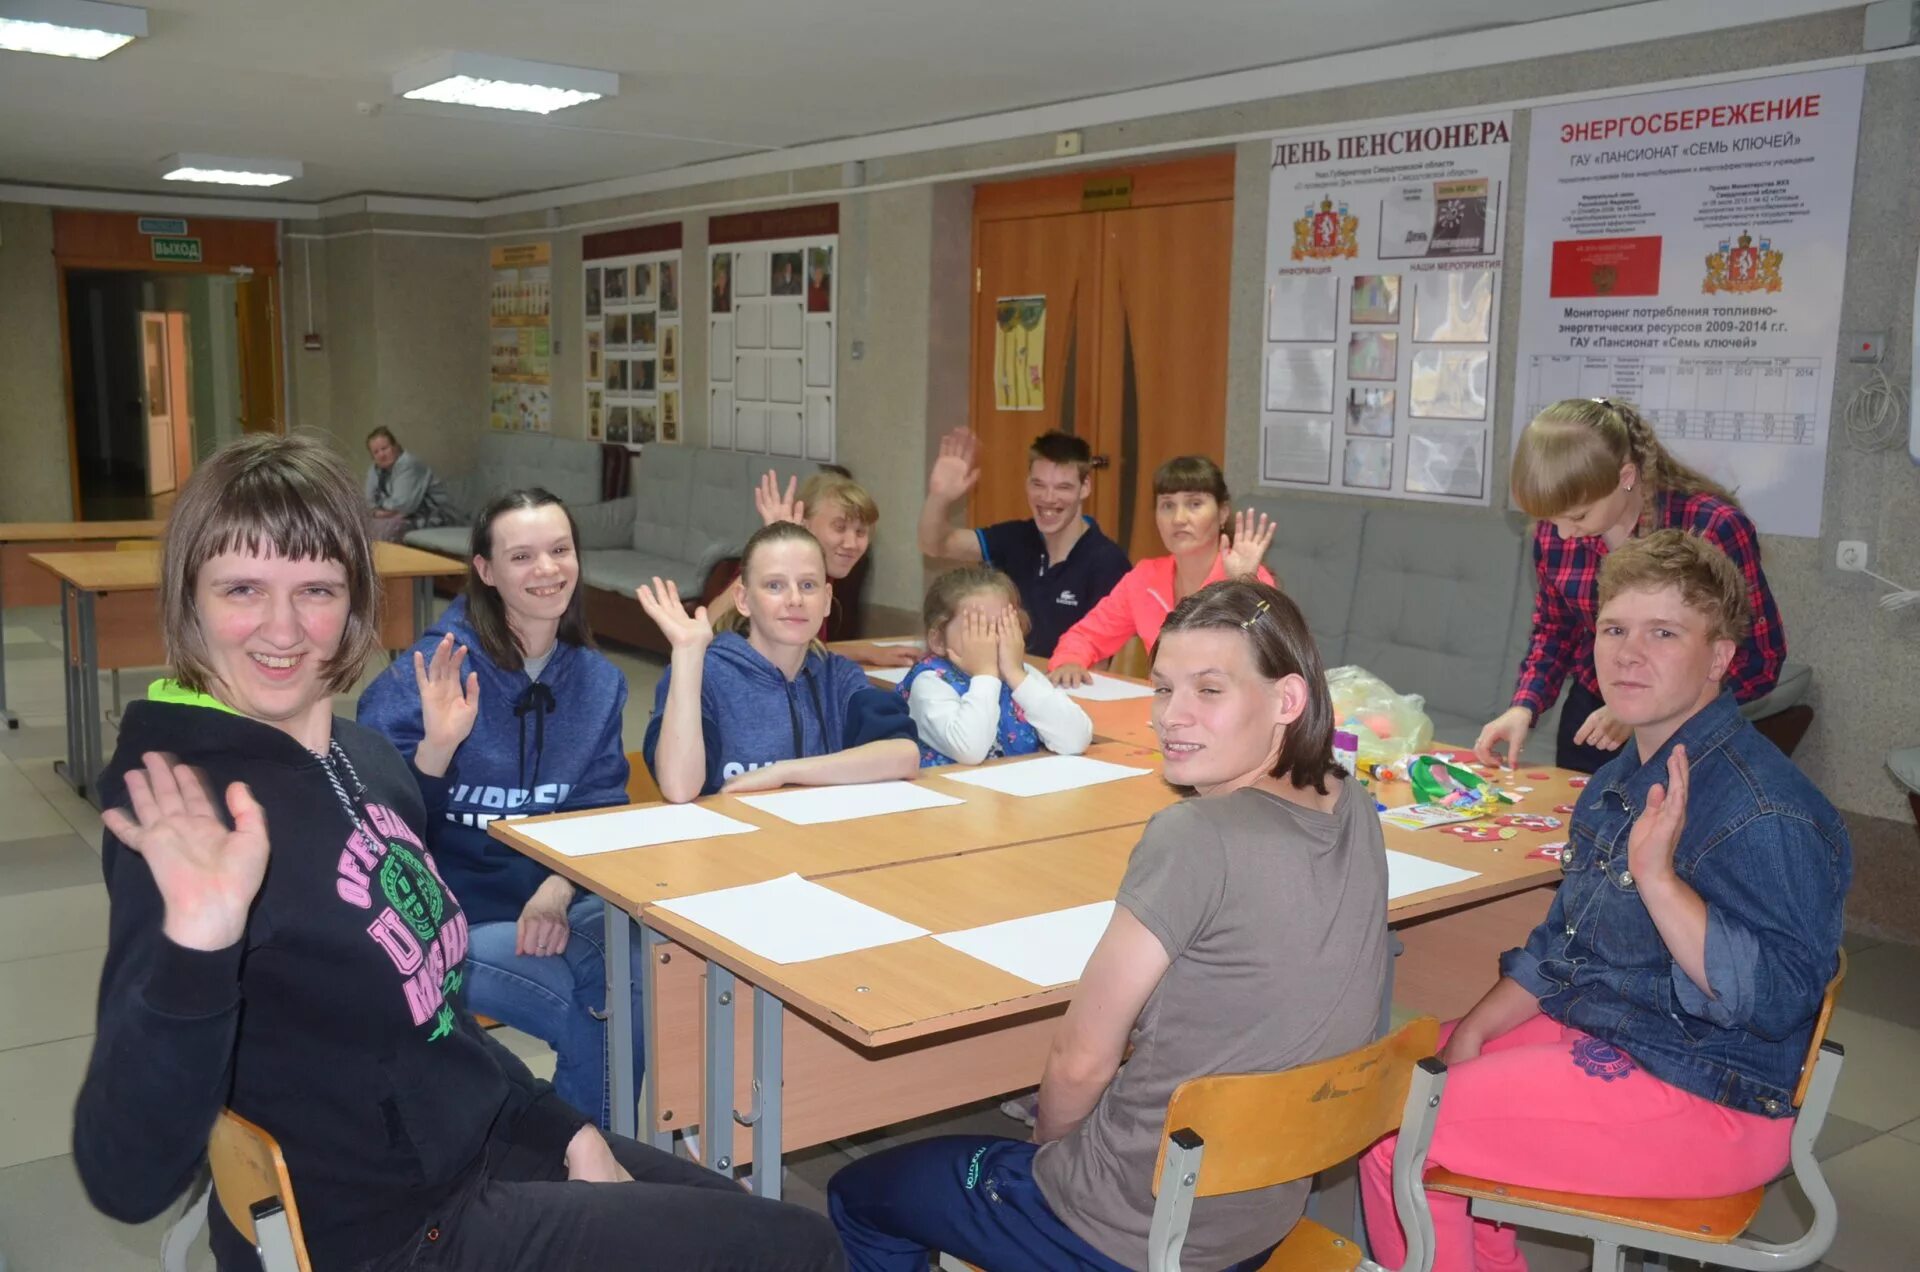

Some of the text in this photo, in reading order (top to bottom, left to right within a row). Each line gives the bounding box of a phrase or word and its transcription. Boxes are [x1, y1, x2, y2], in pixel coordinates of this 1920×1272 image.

[1560, 95, 1821, 144] ЭНЕРГОСБЕРЕЖЕНИЕ
[1272, 120, 1509, 170] ДЕНЬ ПЕНСИОНЕРА
[1570, 153, 1592, 167] ГАУ
[1595, 145, 1678, 164] «ПАНСИОНАТ
[155, 242, 199, 257] ВЫХОД
[1410, 260, 1502, 272] НАШИ МЕРОПРИЯТИЯ
[1564, 306, 1778, 319] Мониторинг потребления топливно-
[1558, 323, 1643, 335] энергетических
[1647, 323, 1702, 335] ресурсов
[1706, 321, 1767, 333] 2009-2014
[1570, 337, 1590, 348] ГАУ
[1593, 336, 1659, 348] «Пансионат
[1703, 337, 1757, 348] ключей»
[1705, 366, 1722, 376] 2011
[1734, 367, 1752, 376] 2012
[1795, 368, 1813, 377] 2014
